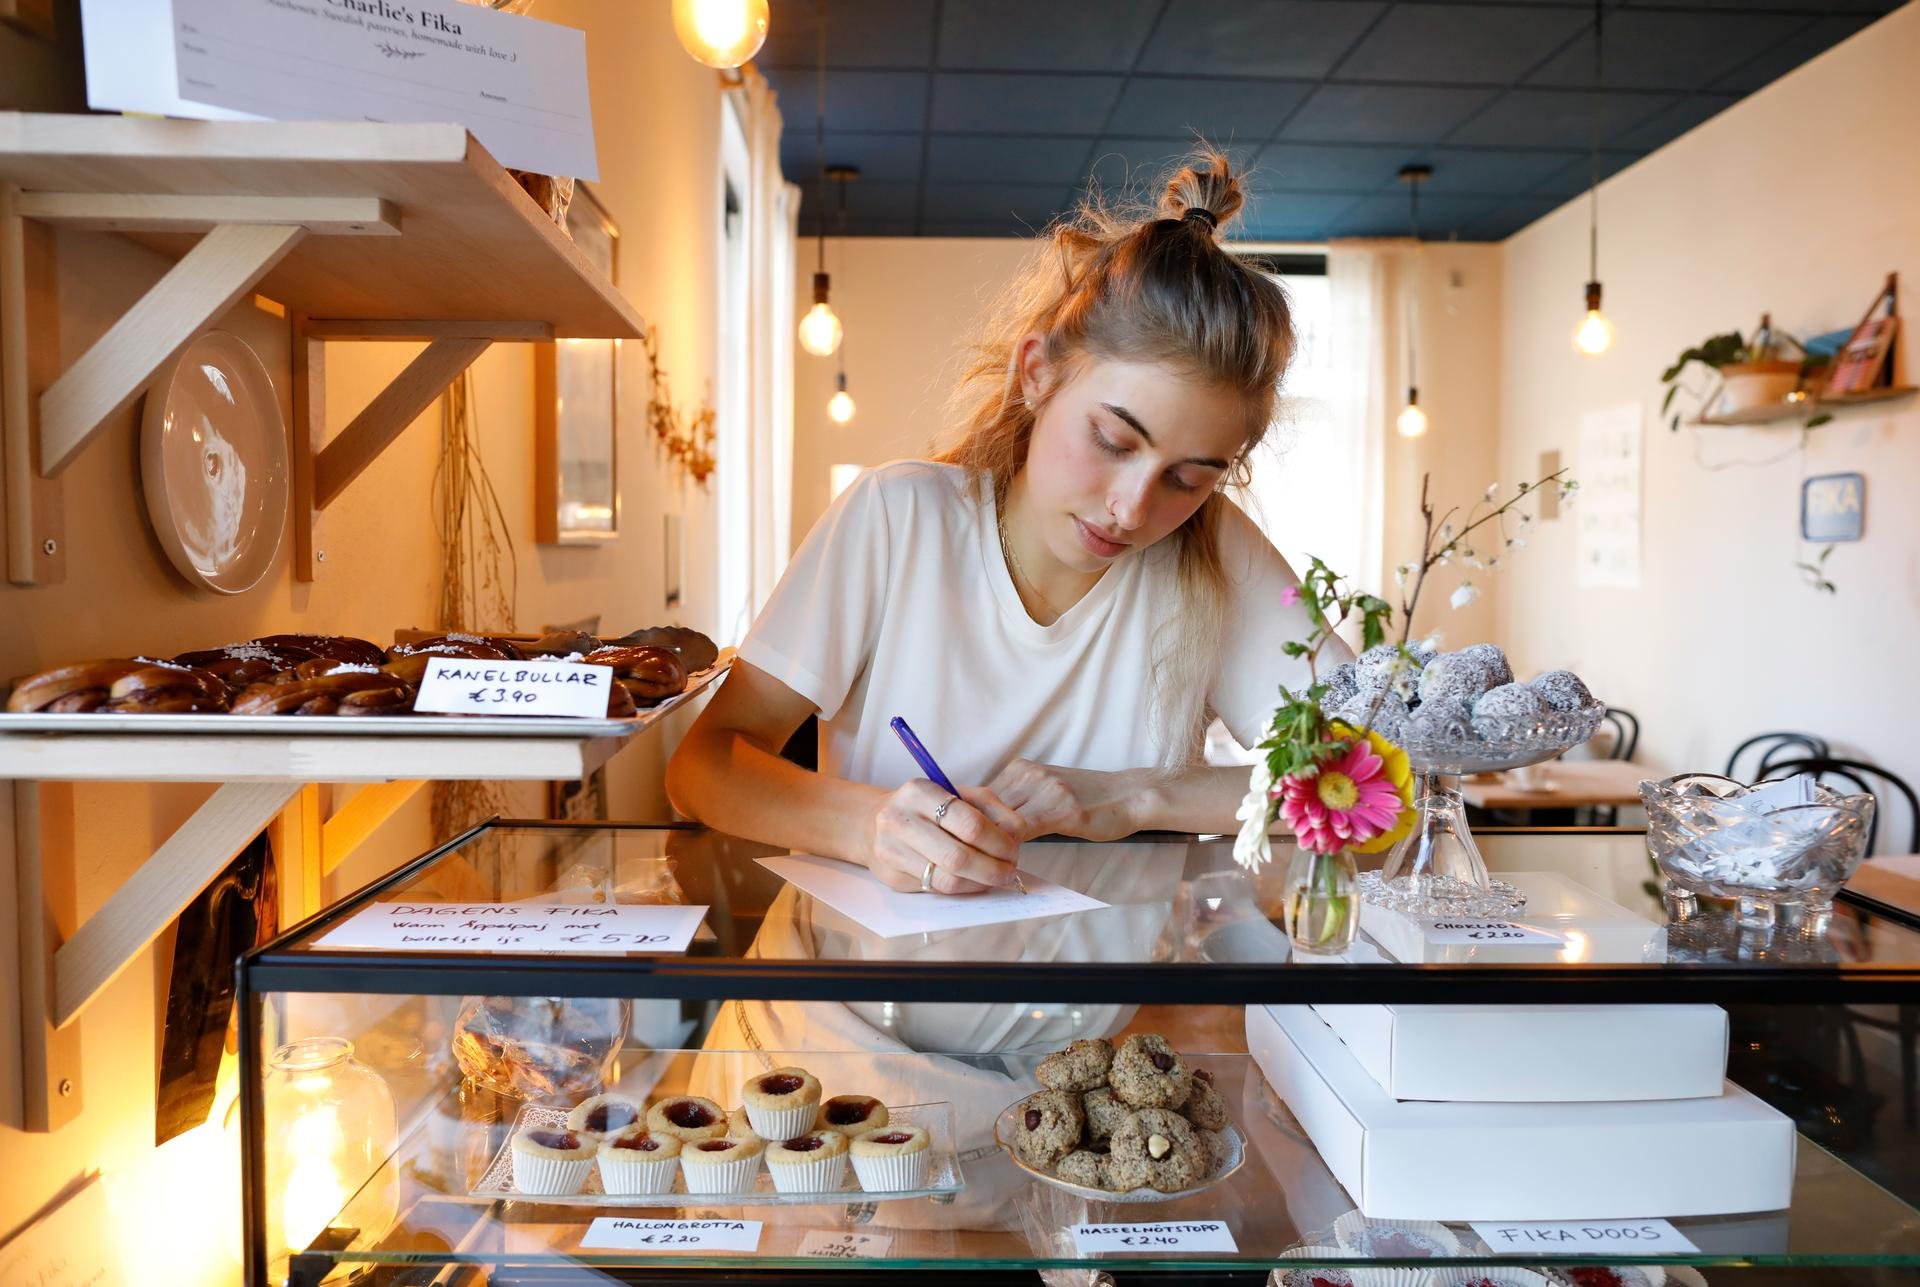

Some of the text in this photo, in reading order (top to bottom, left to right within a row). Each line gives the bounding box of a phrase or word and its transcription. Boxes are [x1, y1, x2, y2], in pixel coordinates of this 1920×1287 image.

[420, 11, 463, 35] Fika
[411, 29, 463, 50] homemade
[465, 43, 487, 56] with
[489, 46, 508, 61] love
[437, 668, 598, 686] KANELBULLAR
[390, 906, 619, 916] DAGENS FIKA
[393, 921, 445, 929] Warm
[402, 935, 480, 943] bolletje
[497, 935, 524, 944] ijs
[613, 1221, 745, 1230] HALLONGROTTA
[1080, 1224, 1220, 1235] HASSELNÖTSTOPP
[1497, 1226, 1661, 1242] FIKA DOOS
